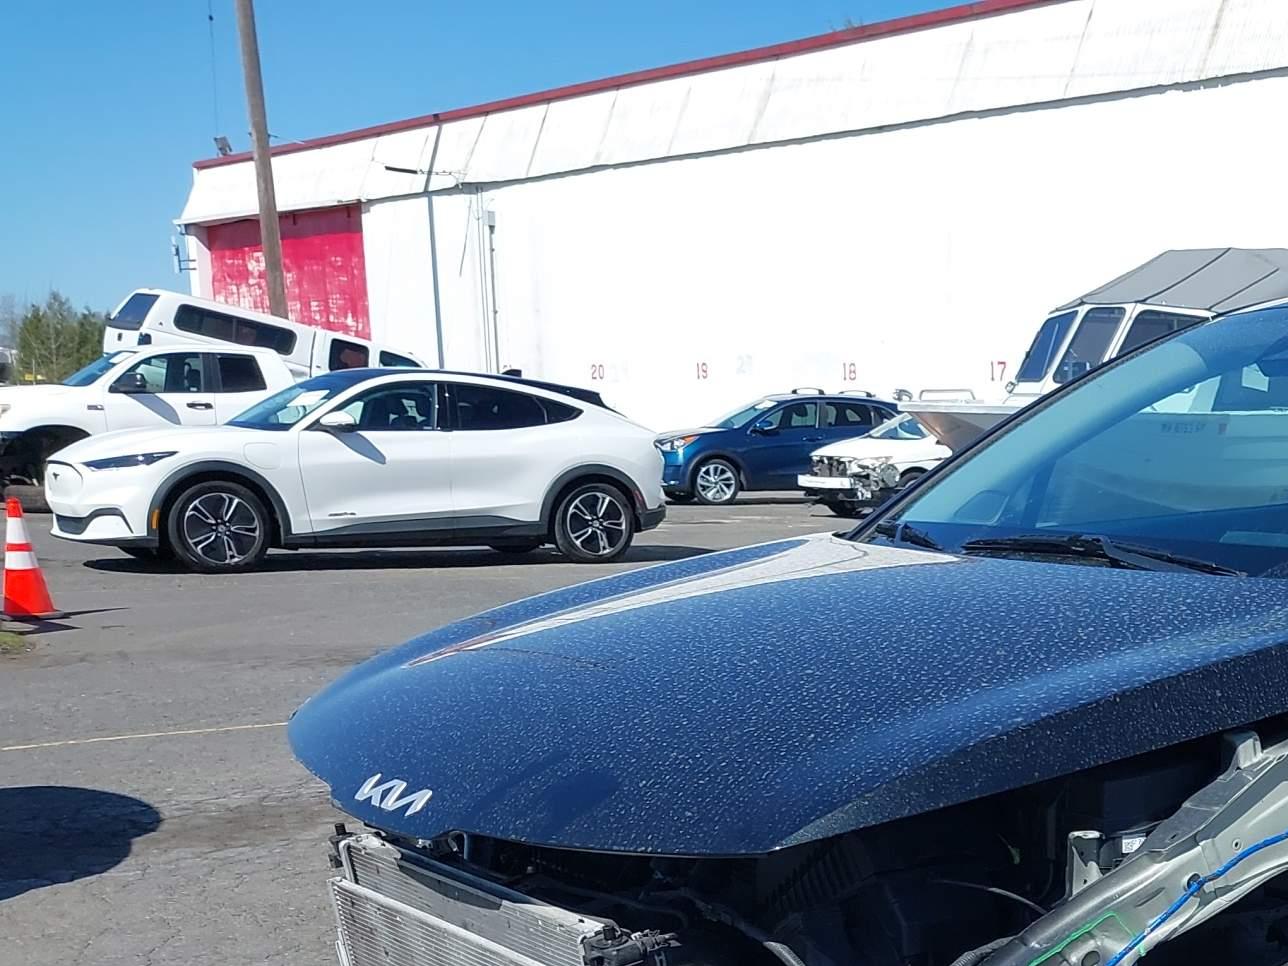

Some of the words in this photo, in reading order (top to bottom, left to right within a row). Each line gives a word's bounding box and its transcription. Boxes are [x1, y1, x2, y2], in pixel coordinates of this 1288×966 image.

[590, 363, 605, 380] 20
[696, 362, 709, 380] 19
[842, 362, 857, 381] 18
[990, 360, 1007, 382] 17
